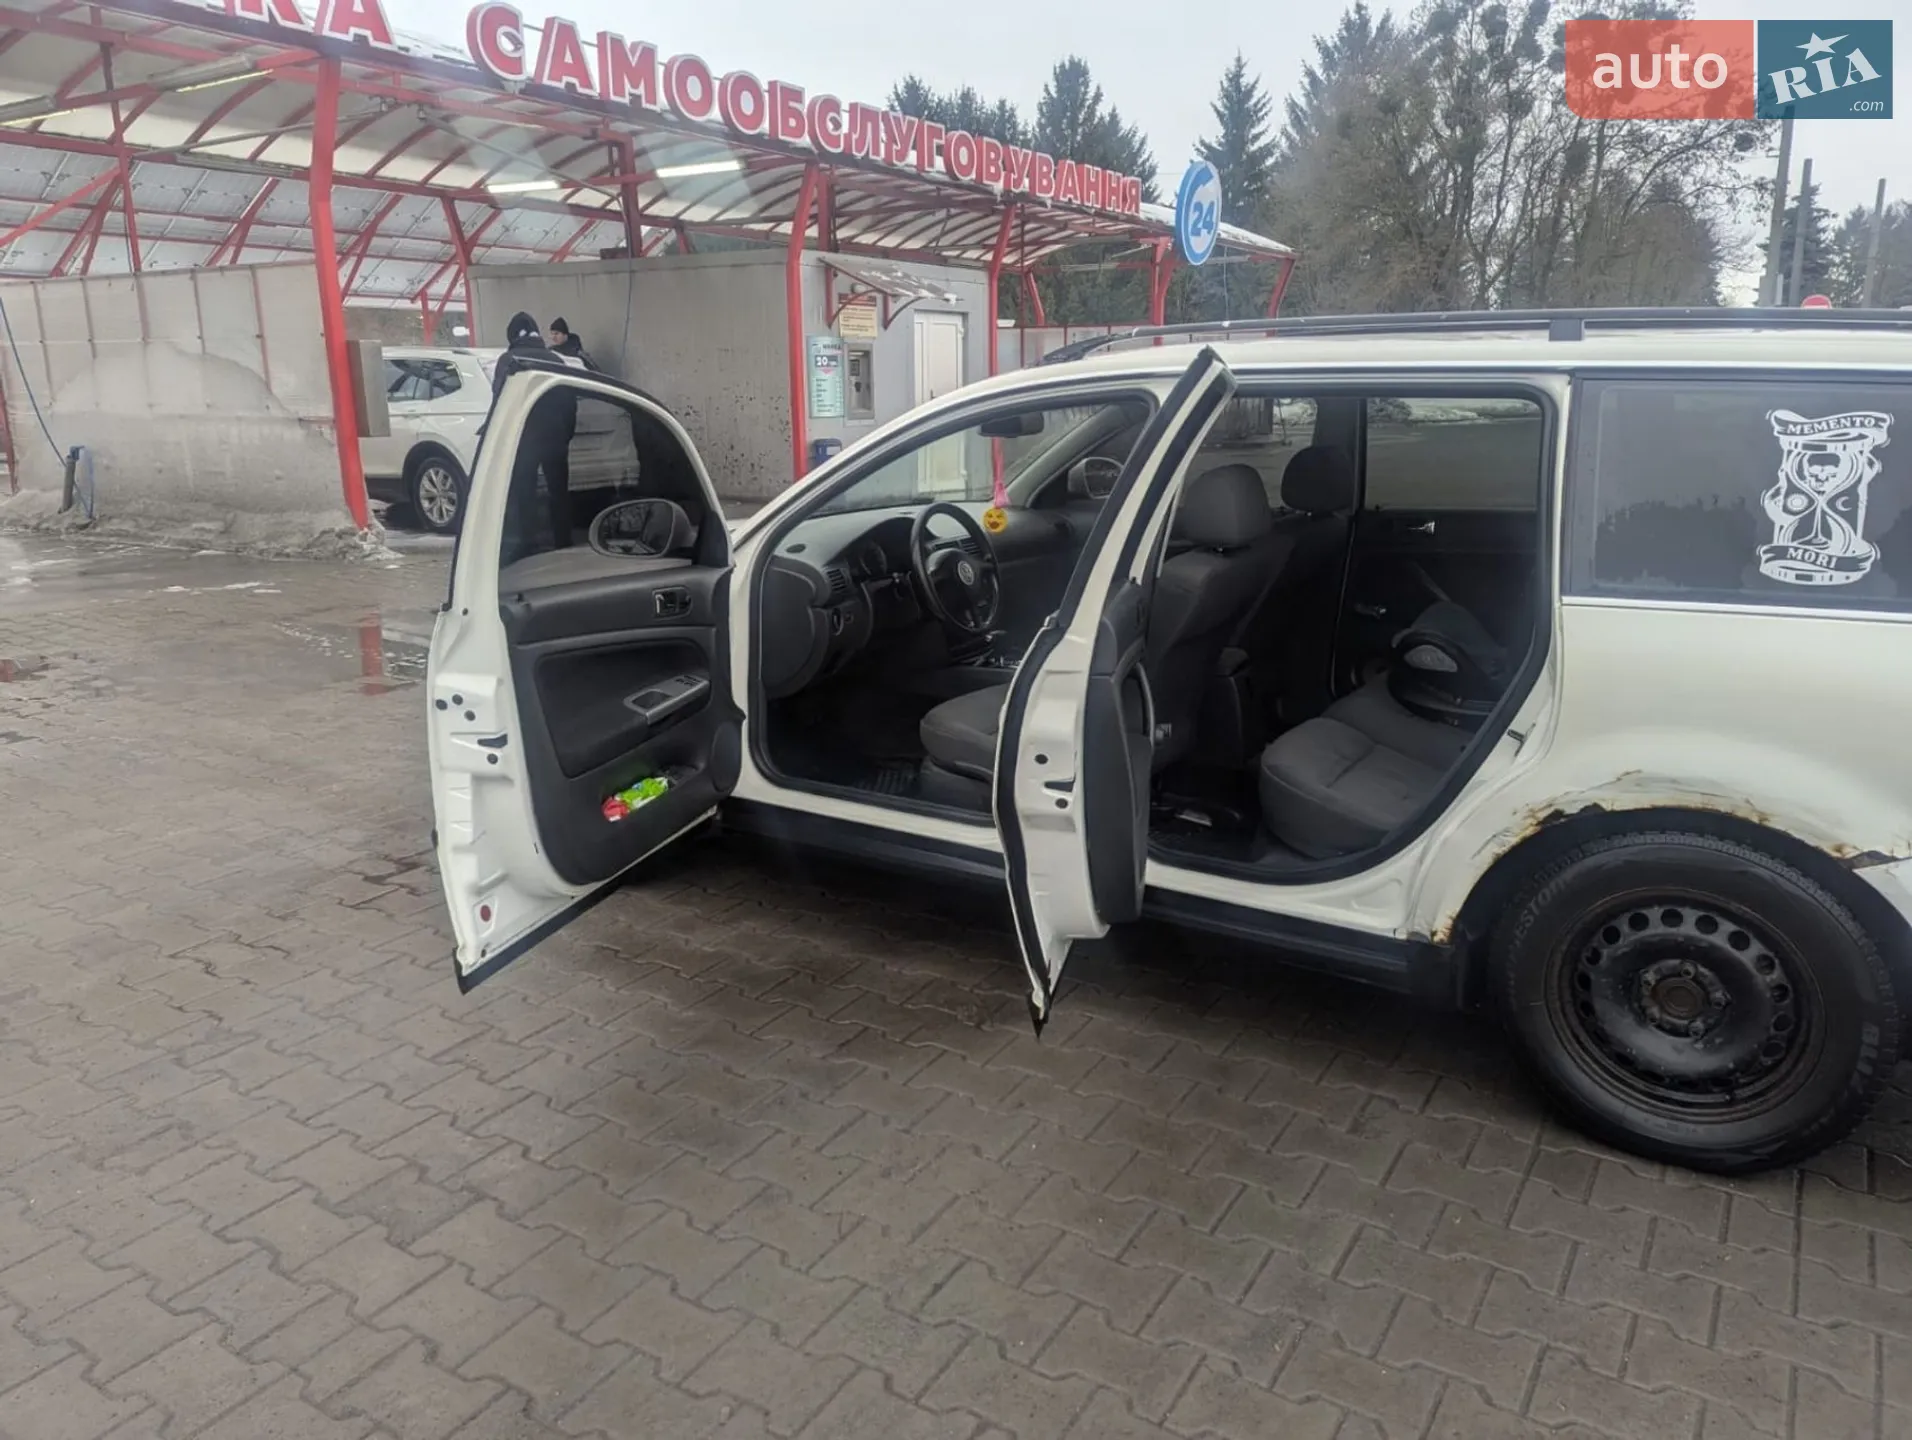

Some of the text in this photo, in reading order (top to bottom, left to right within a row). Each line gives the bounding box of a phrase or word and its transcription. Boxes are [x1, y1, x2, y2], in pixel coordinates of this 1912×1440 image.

[466, 2, 1142, 213] САМООБСЛУГОВУВАННЯ
[1190, 201, 1215, 236] 24
[1786, 416, 1876, 435] MEMENTO
[1786, 547, 1838, 568] MORI
